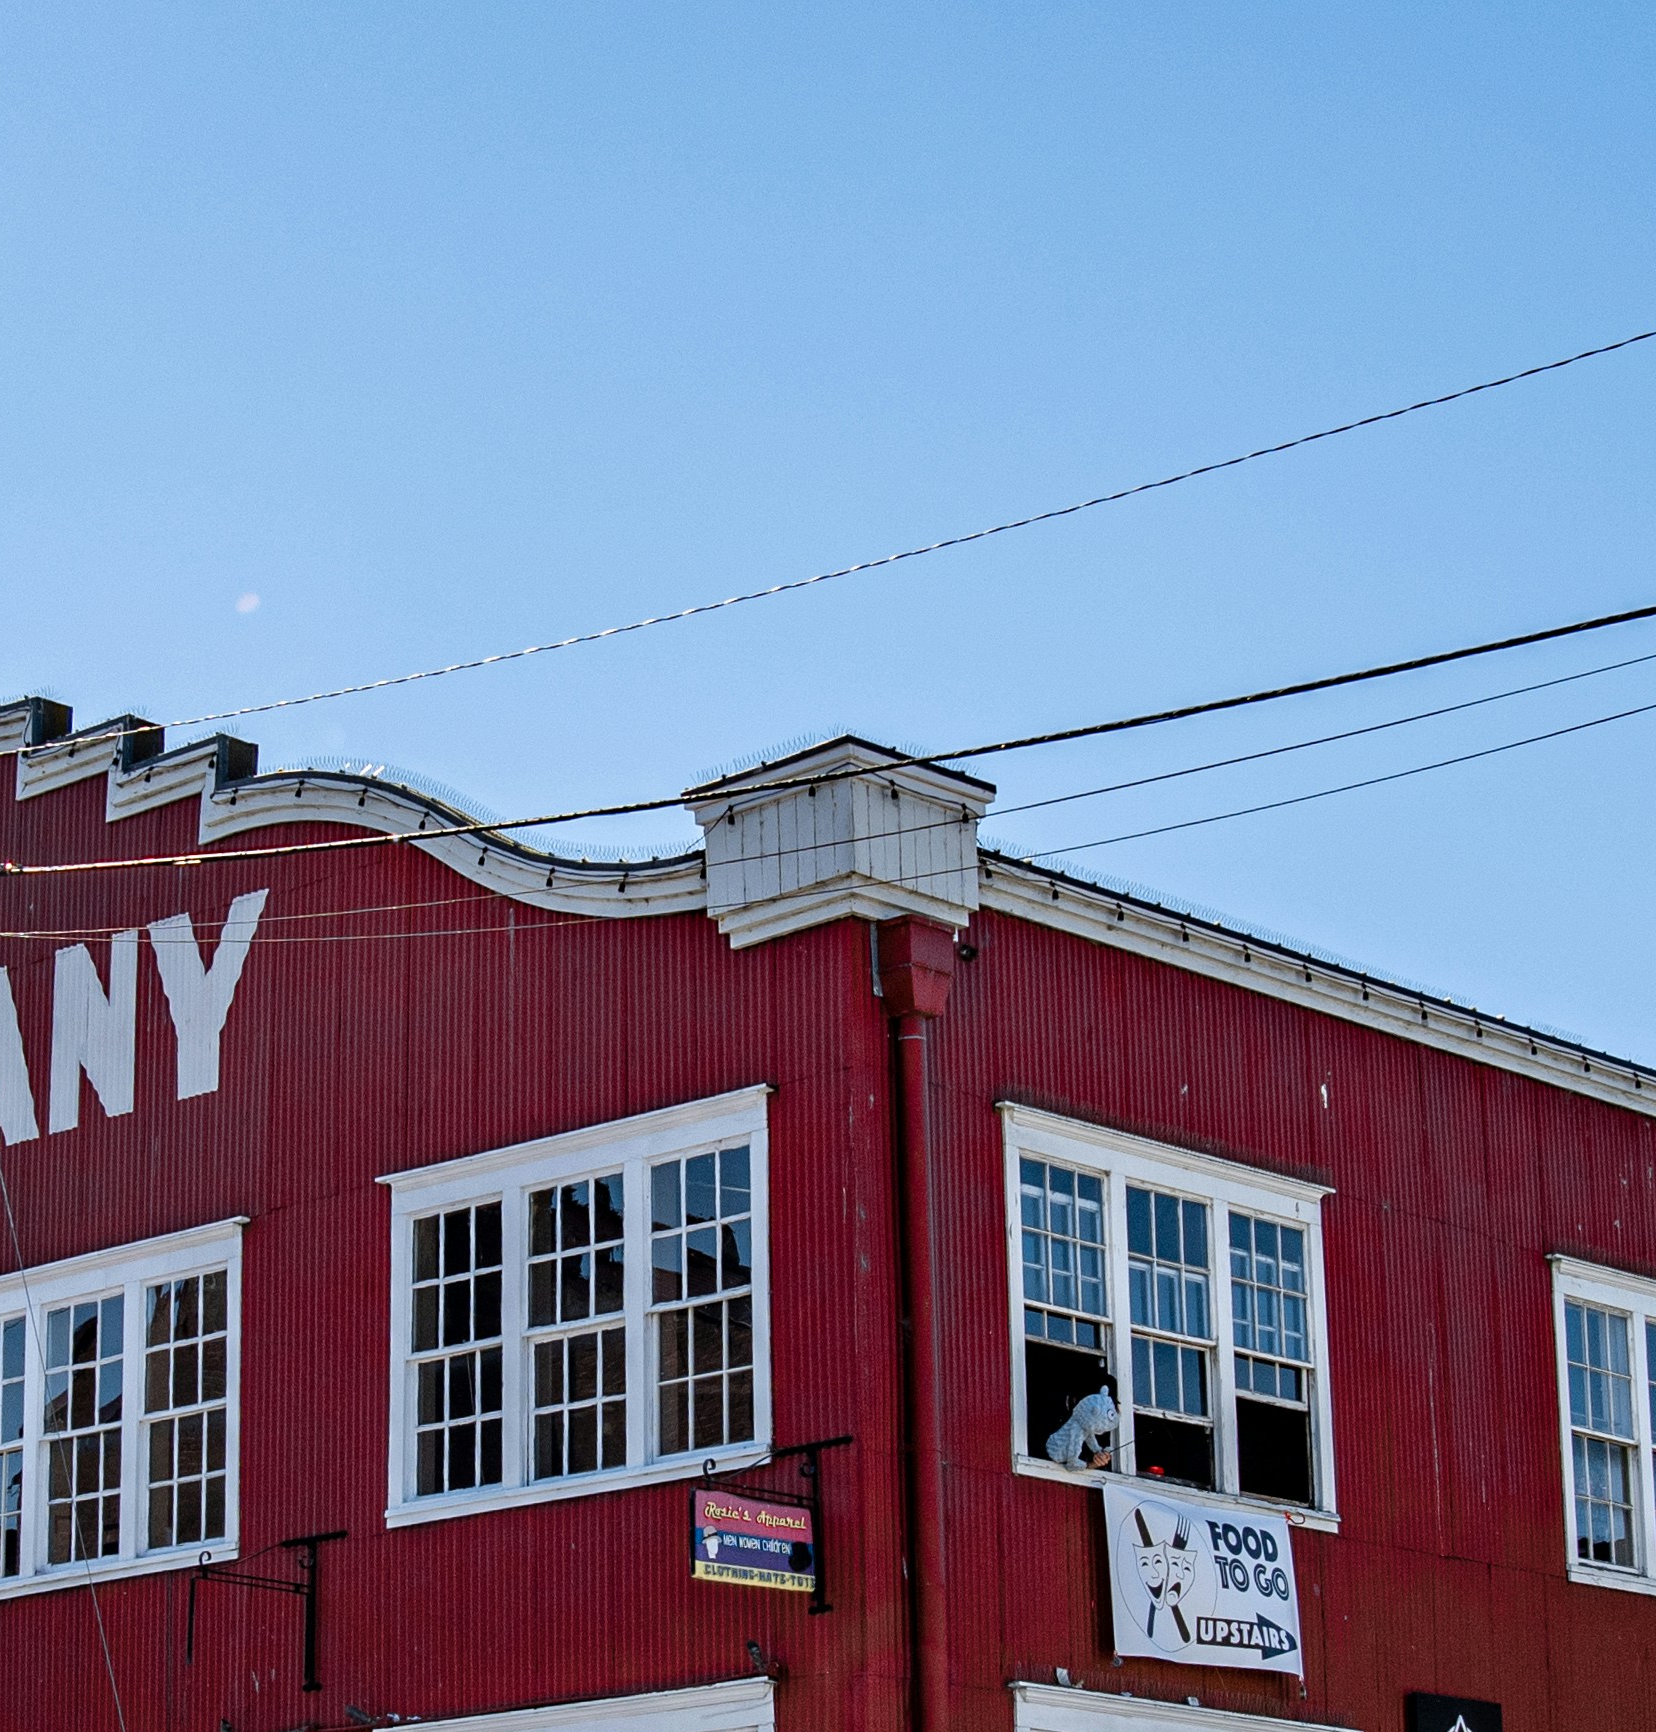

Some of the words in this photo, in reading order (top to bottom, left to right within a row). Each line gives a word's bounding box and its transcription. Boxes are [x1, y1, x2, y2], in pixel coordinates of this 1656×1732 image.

[705, 1501, 751, 1521] Rosie's
[756, 1510, 807, 1530] Apparel
[1205, 1519, 1278, 1563] FOOD
[1214, 1555, 1249, 1593] TO
[1253, 1563, 1289, 1601] GO
[1199, 1619, 1290, 1651] UPSTAIRS
